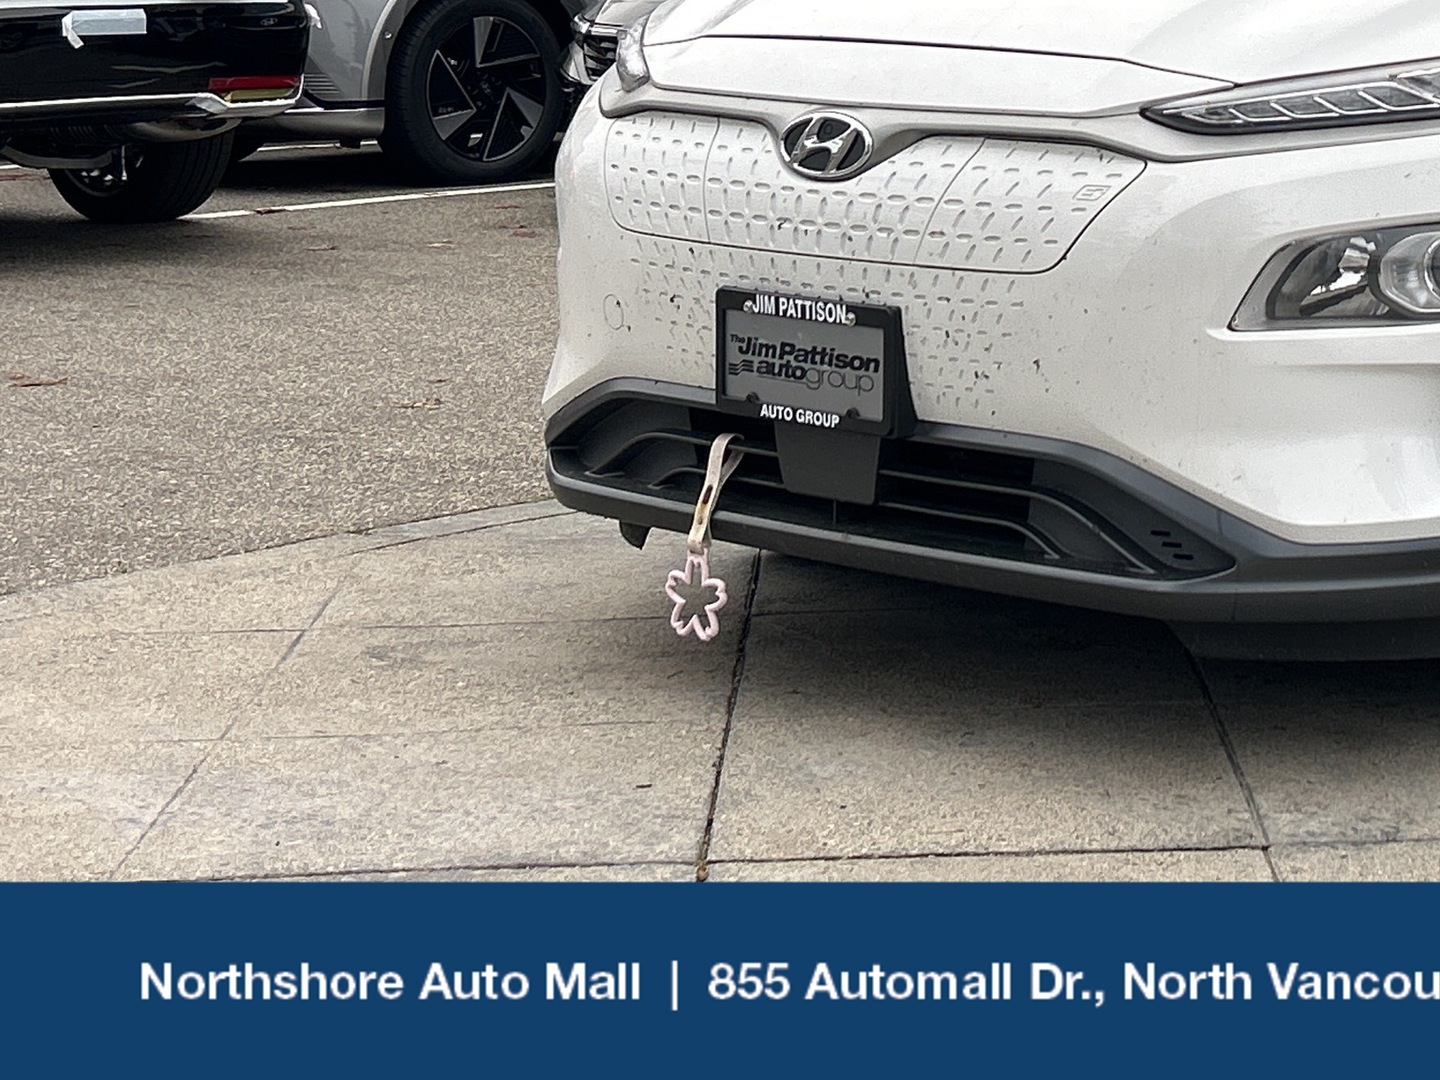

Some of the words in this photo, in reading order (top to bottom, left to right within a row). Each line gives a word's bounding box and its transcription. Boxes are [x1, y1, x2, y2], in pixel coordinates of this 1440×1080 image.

[753, 294, 776, 315] JIM
[778, 297, 847, 325] PATTISON
[760, 403, 793, 421] AUTO
[795, 408, 840, 428] GROUP
